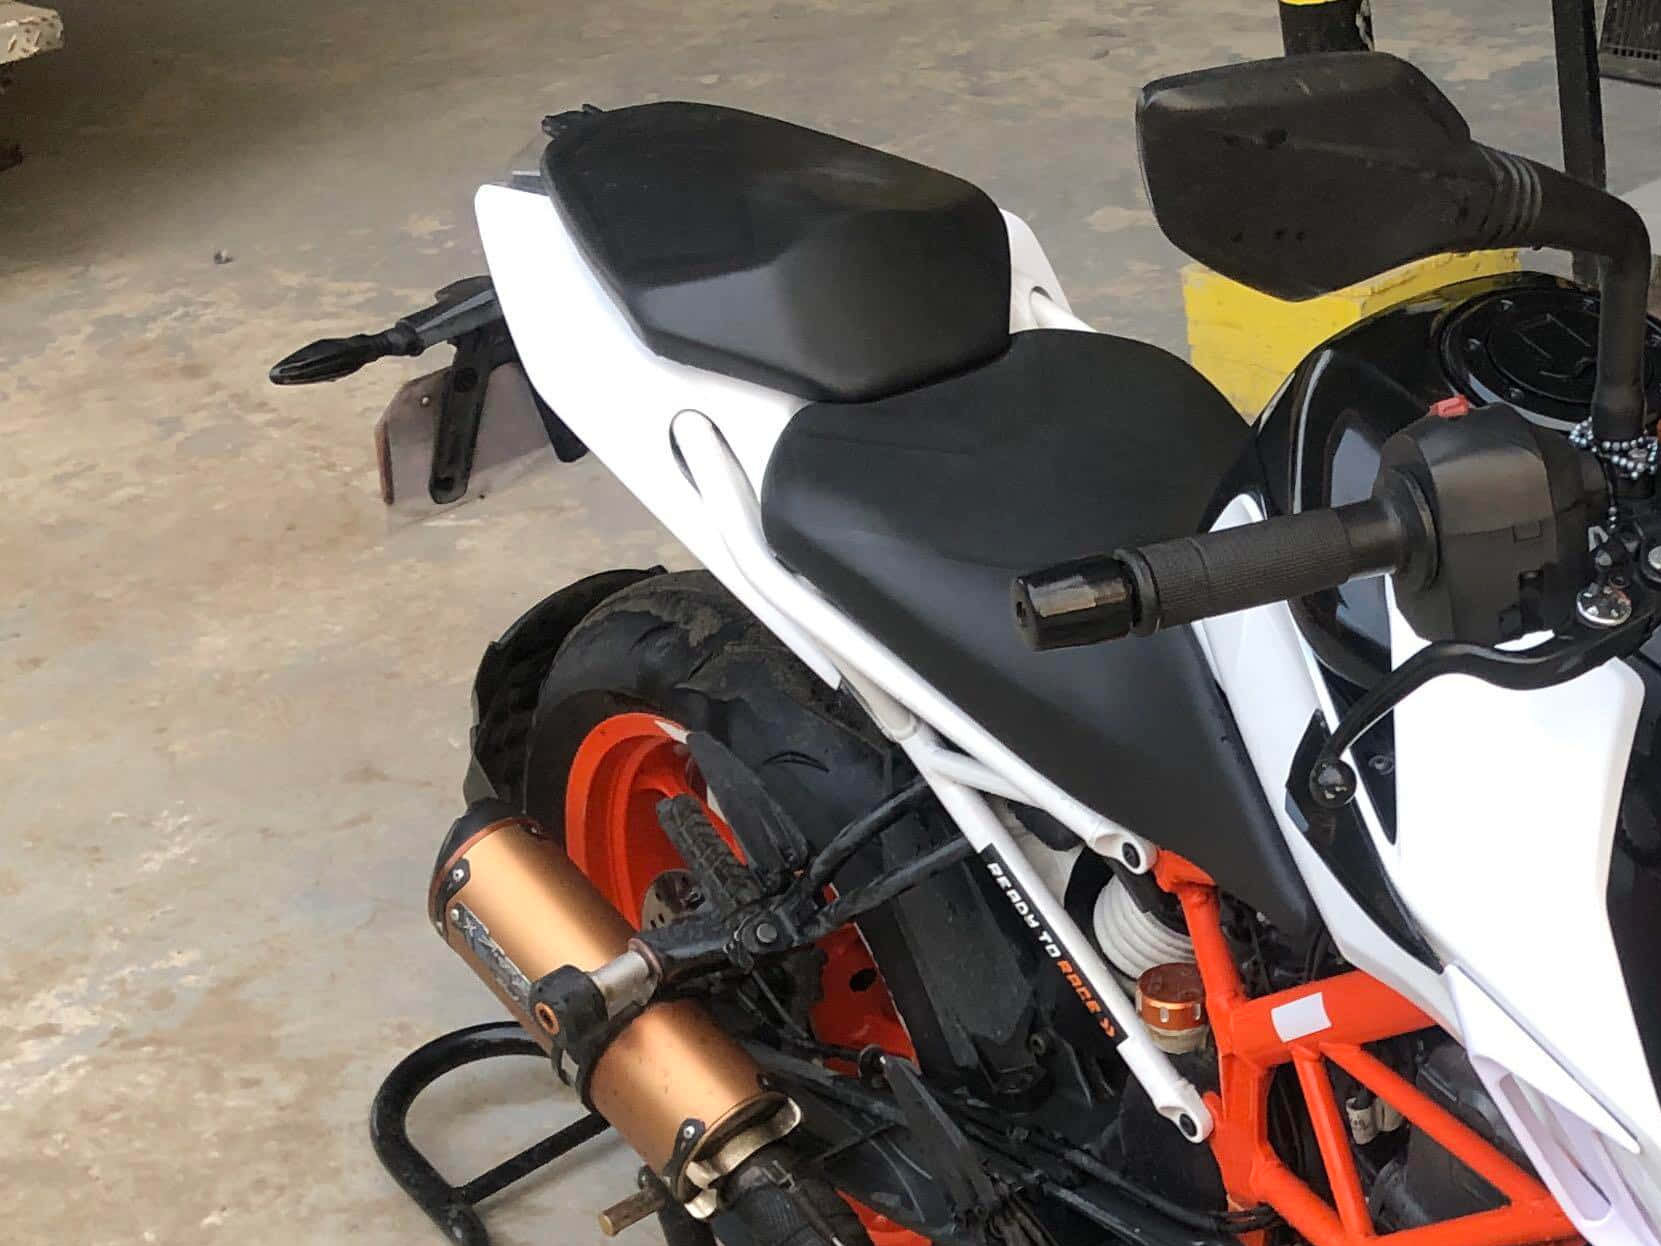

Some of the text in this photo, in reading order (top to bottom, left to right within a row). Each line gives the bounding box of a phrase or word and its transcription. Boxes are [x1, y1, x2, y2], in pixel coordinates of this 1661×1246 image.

[987, 862, 1101, 1014] READY TO RACE
